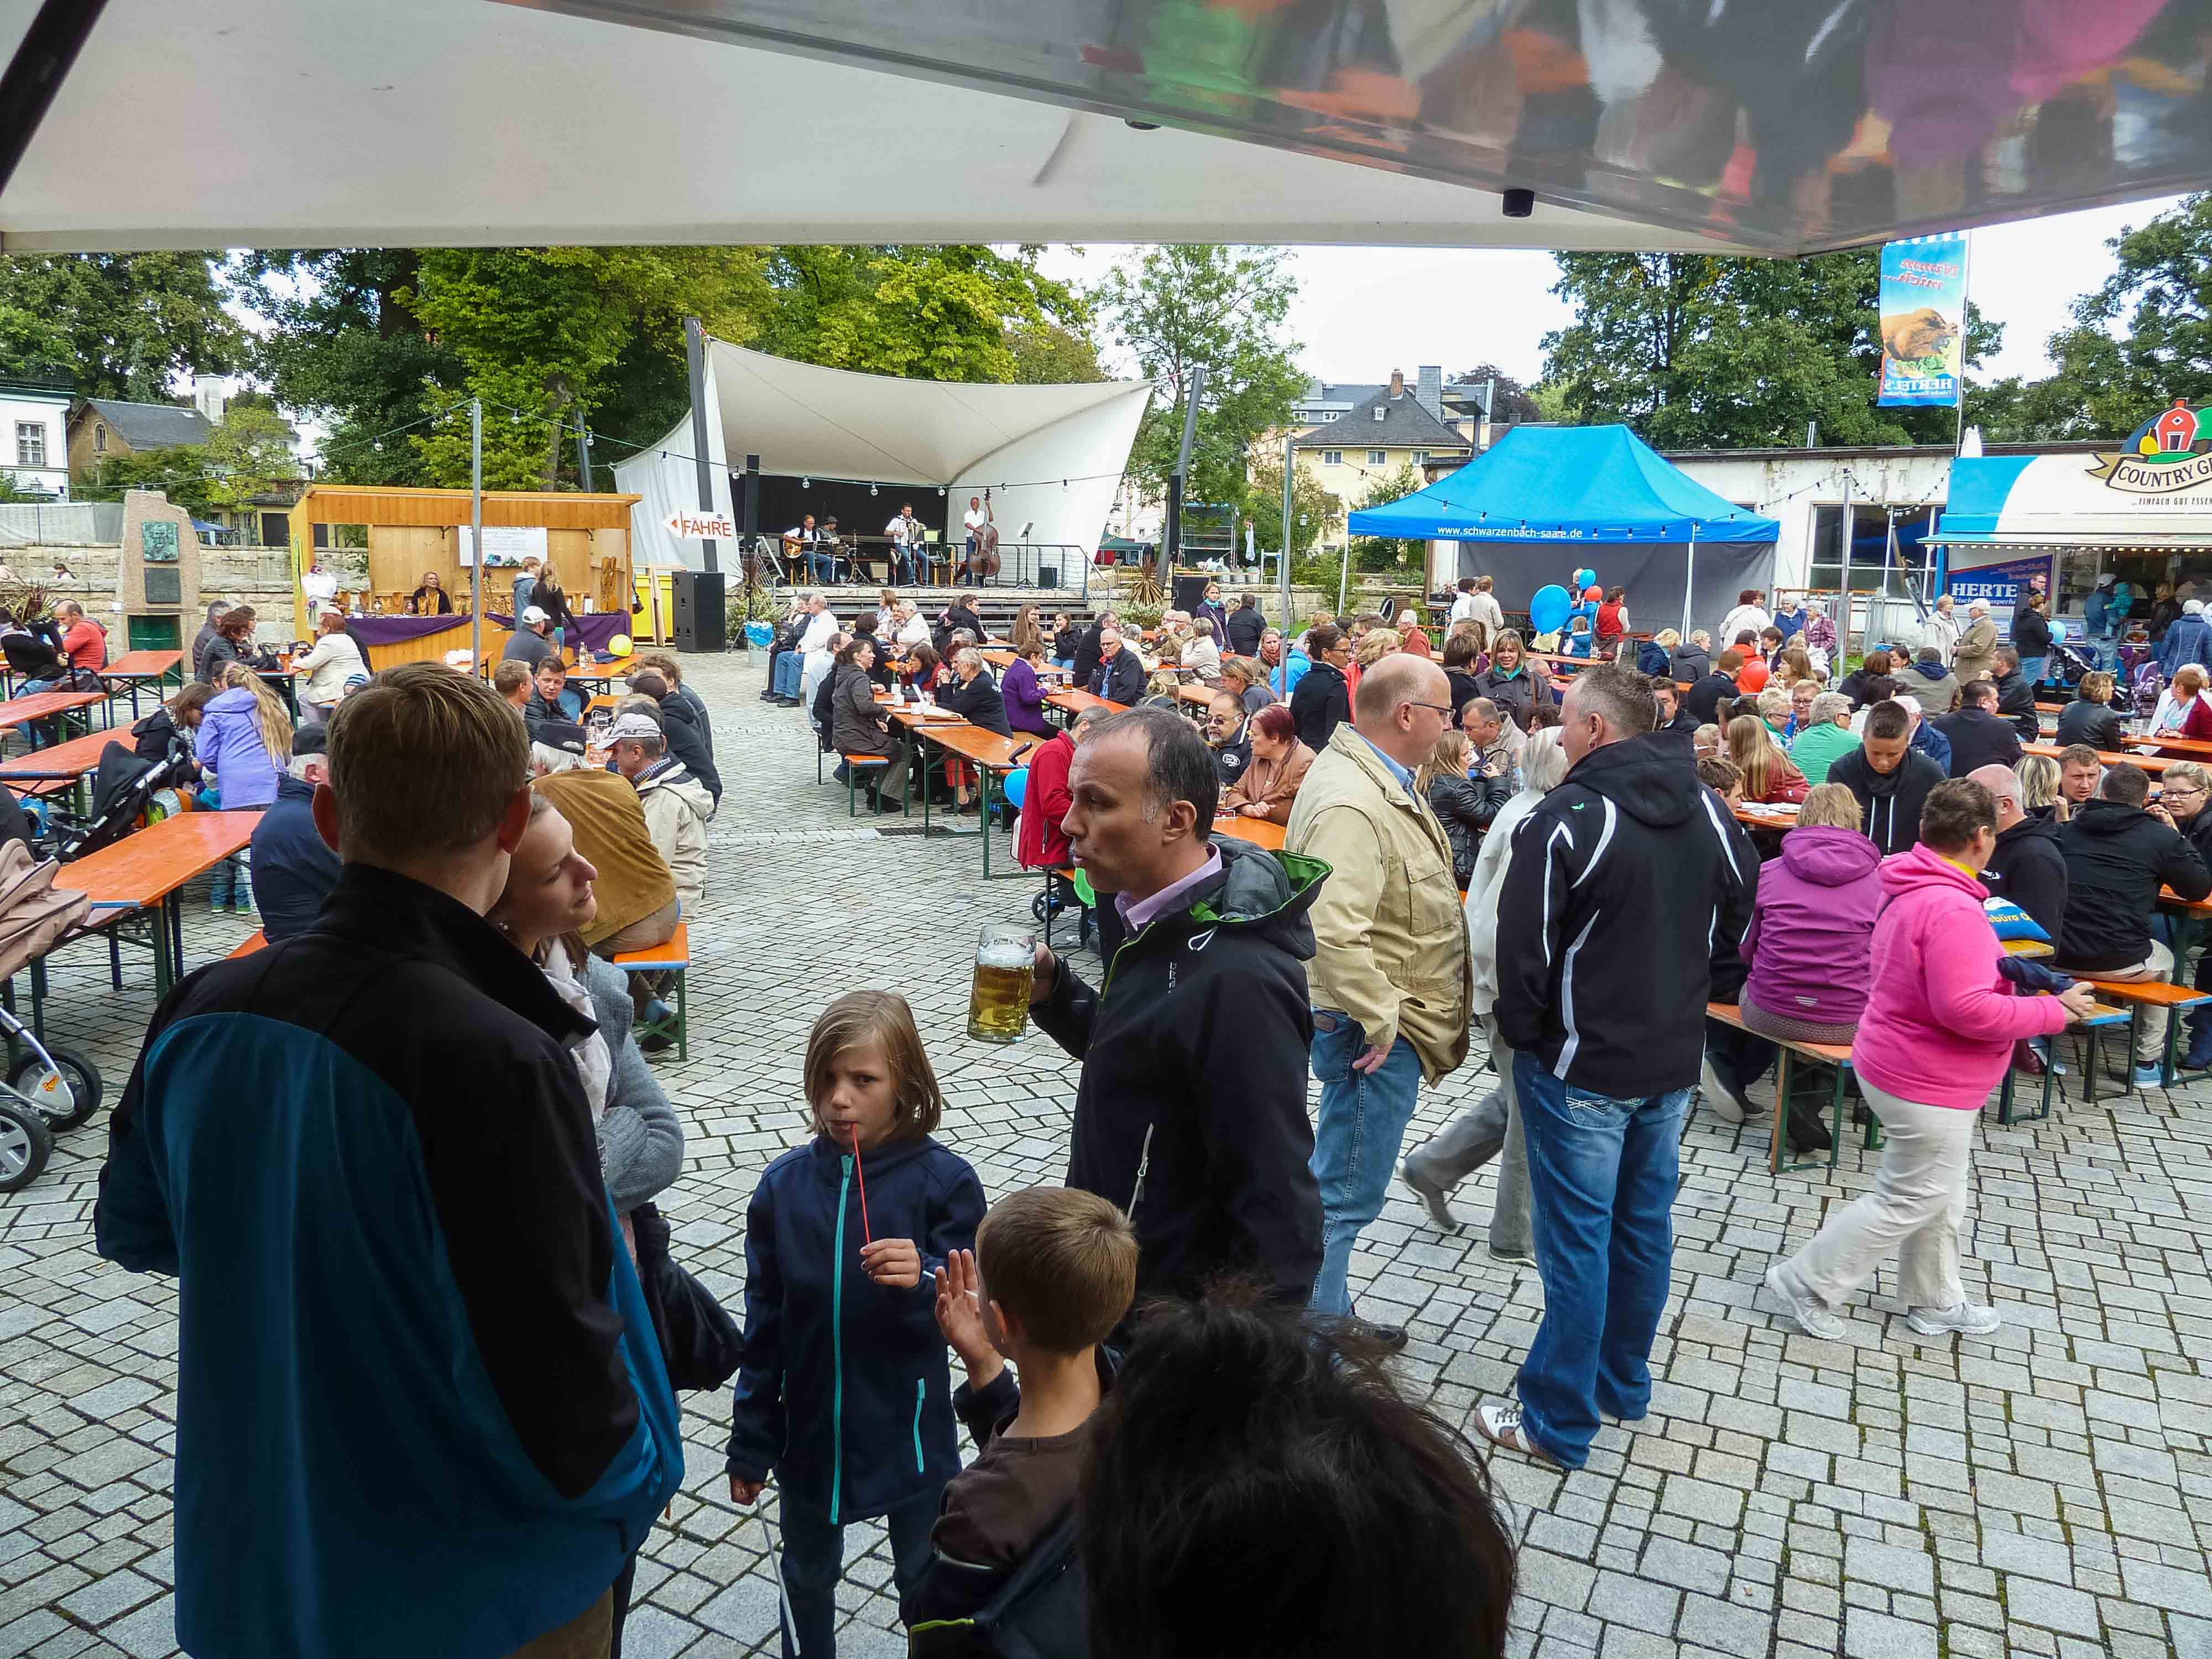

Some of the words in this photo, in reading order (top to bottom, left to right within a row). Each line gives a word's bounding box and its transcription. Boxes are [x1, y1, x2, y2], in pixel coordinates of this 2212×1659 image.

[2118, 464, 2193, 487] COUNTRY
[684, 518, 731, 537] FÄHRE
[1438, 526, 1583, 538] www.schwarzenbach-saae.de
[1951, 583, 2017, 597] HERTE
